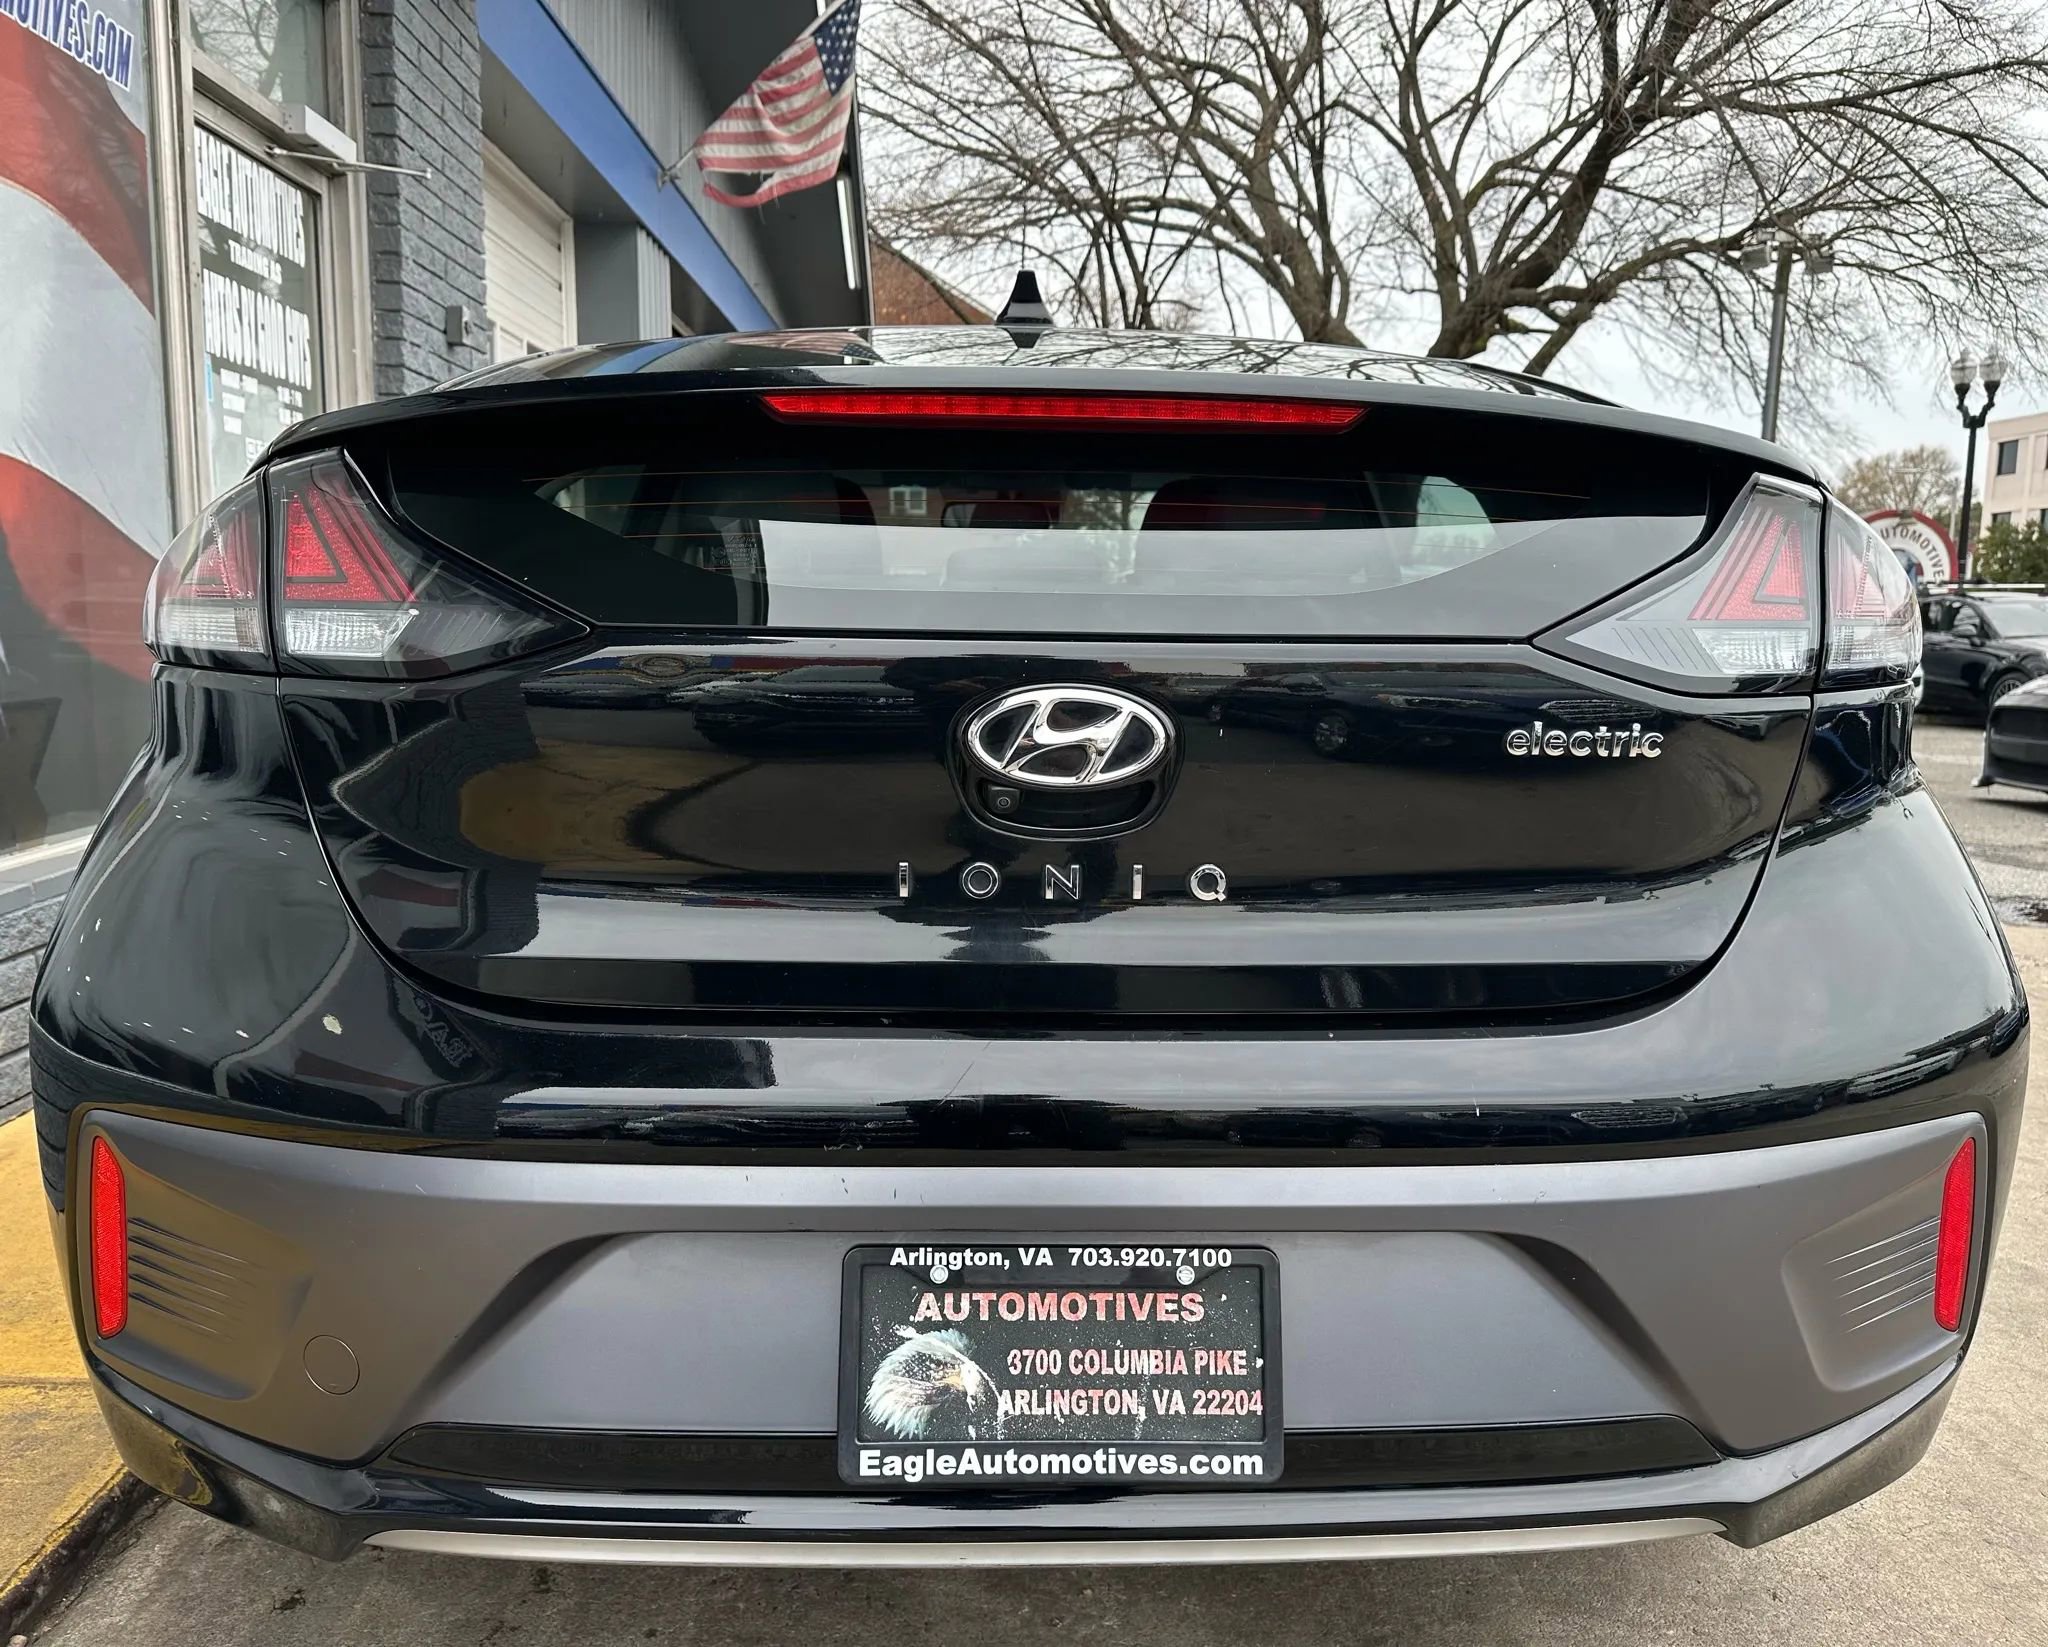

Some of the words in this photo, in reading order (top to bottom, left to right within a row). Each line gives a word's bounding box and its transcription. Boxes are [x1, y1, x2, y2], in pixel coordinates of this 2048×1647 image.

[0, 0, 134, 91] IVES.COM
[194, 124, 233, 230] EAGLE
[229, 147, 306, 269] AUTOMOTIVES
[228, 239, 270, 279] TRADING
[203, 268, 242, 365] AUTOS
[1880, 524, 1945, 579] UTOMOTIVE
[1506, 721, 1664, 758] electric
[899, 861, 1227, 902] IONIQ
[889, 1247, 1010, 1270] Arlington,
[1018, 1247, 1054, 1266] VA
[1068, 1247, 1232, 1267] 703.920.7100
[914, 1291, 1205, 1322] AUTOMOTIVES
[1007, 1349, 1062, 1376] 3700
[1068, 1349, 1189, 1376] COLUMBIA
[1194, 1349, 1248, 1376] PIKE
[1152, 1389, 1186, 1416] VA
[1192, 1389, 1263, 1416] 22204
[859, 1448, 1264, 1483] EagleAutomotives.com
